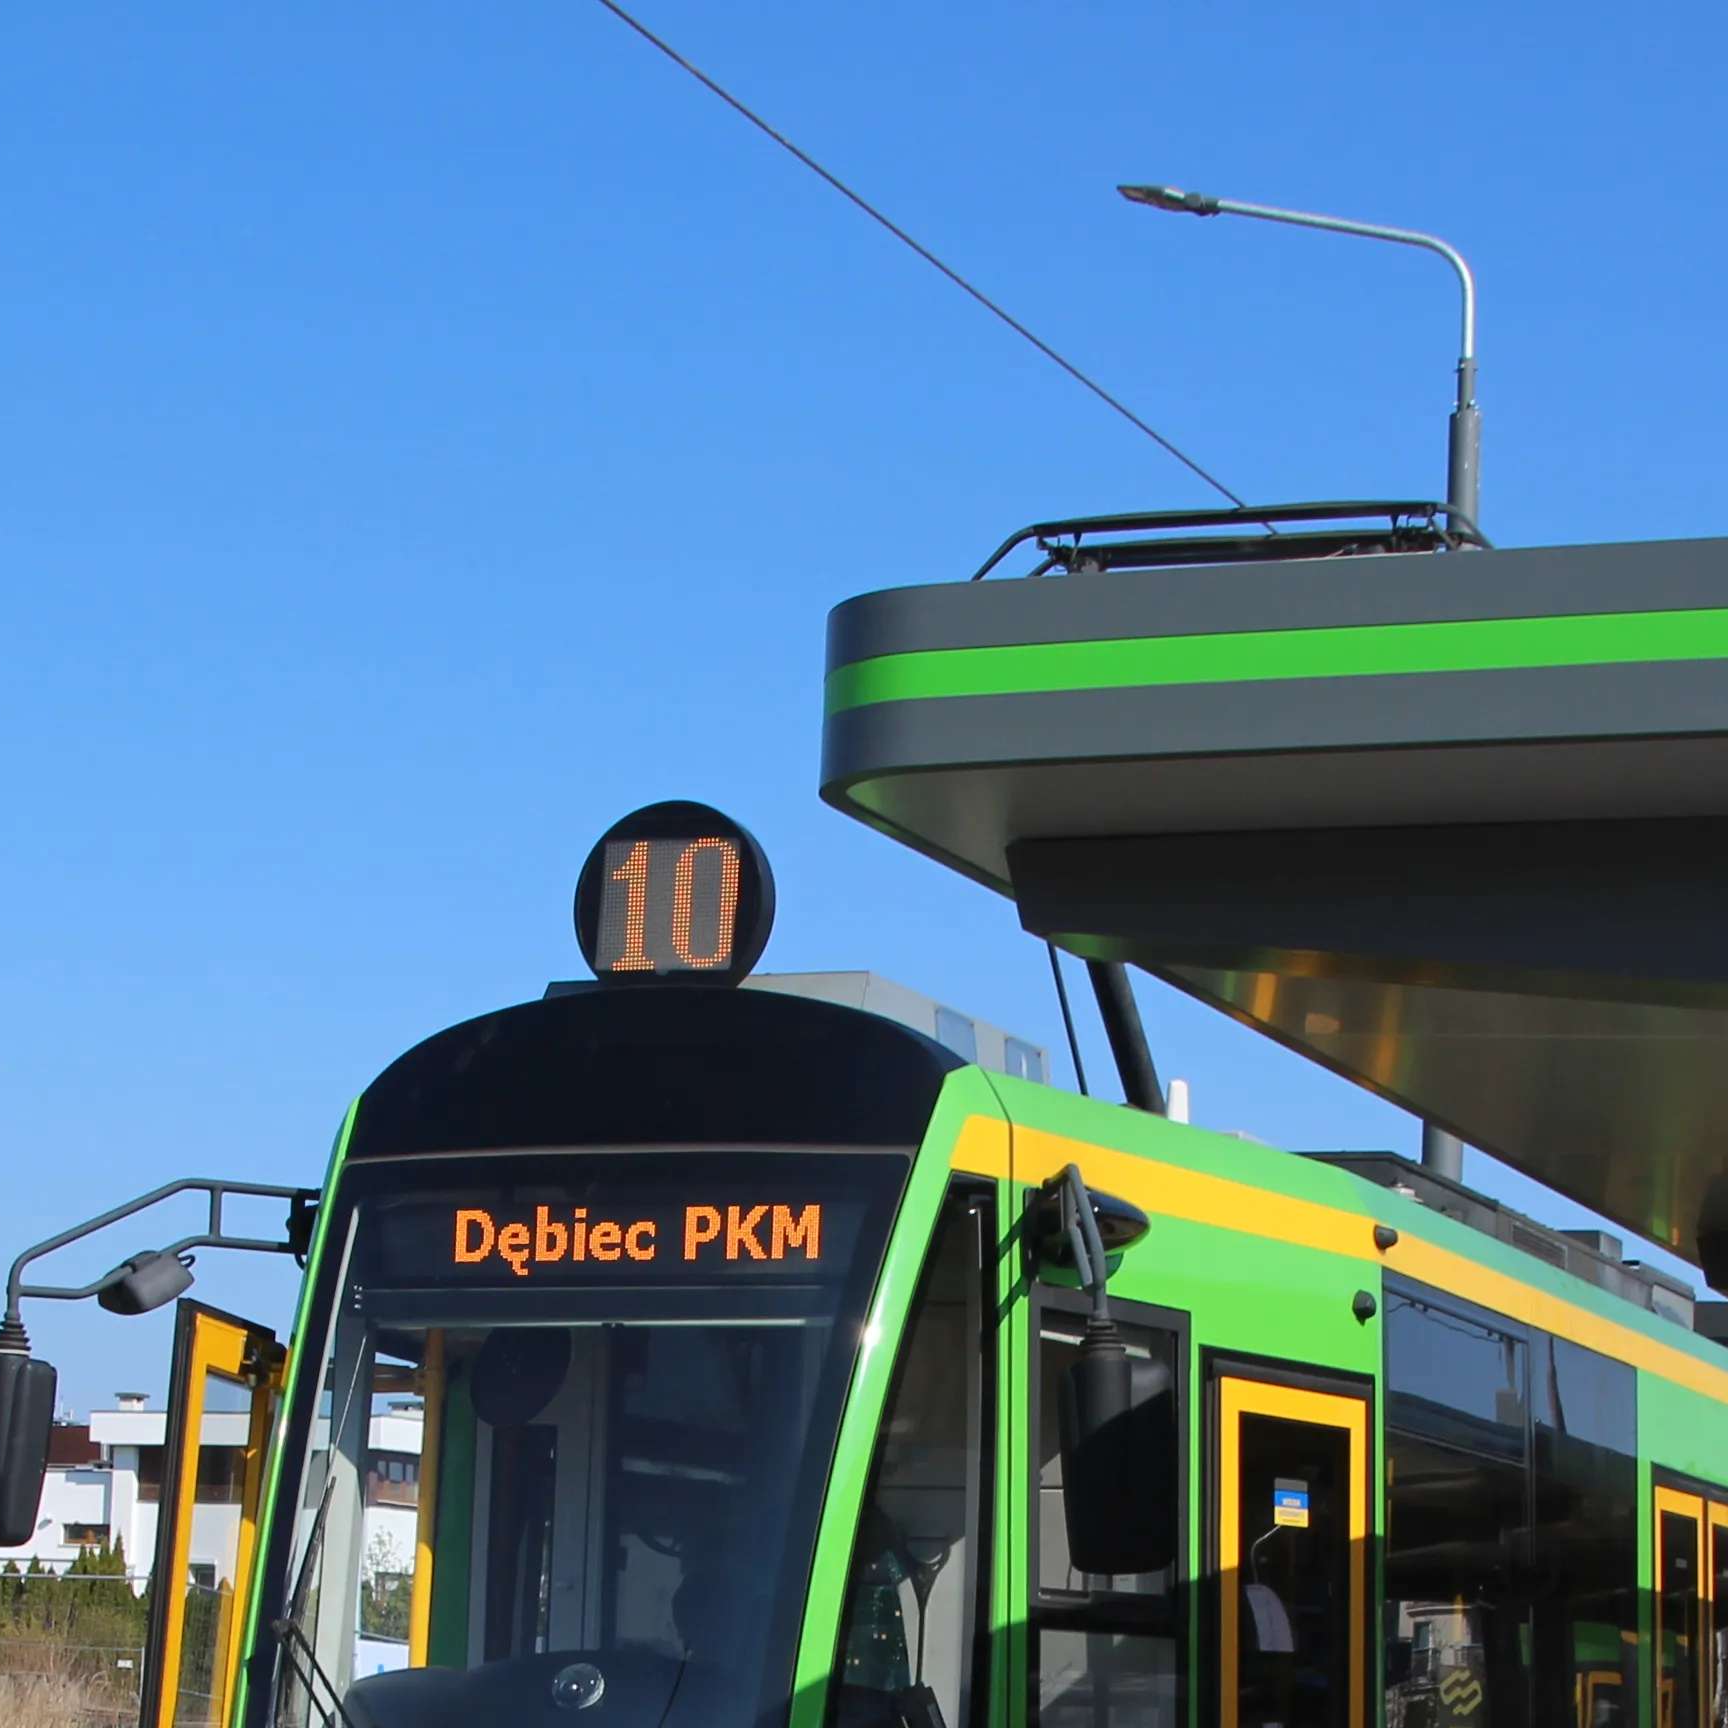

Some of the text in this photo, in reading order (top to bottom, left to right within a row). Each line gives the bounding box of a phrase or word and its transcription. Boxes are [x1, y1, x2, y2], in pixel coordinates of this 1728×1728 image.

[610, 836, 741, 971] 10
[453, 1203, 822, 1276] Dębiec PKM
